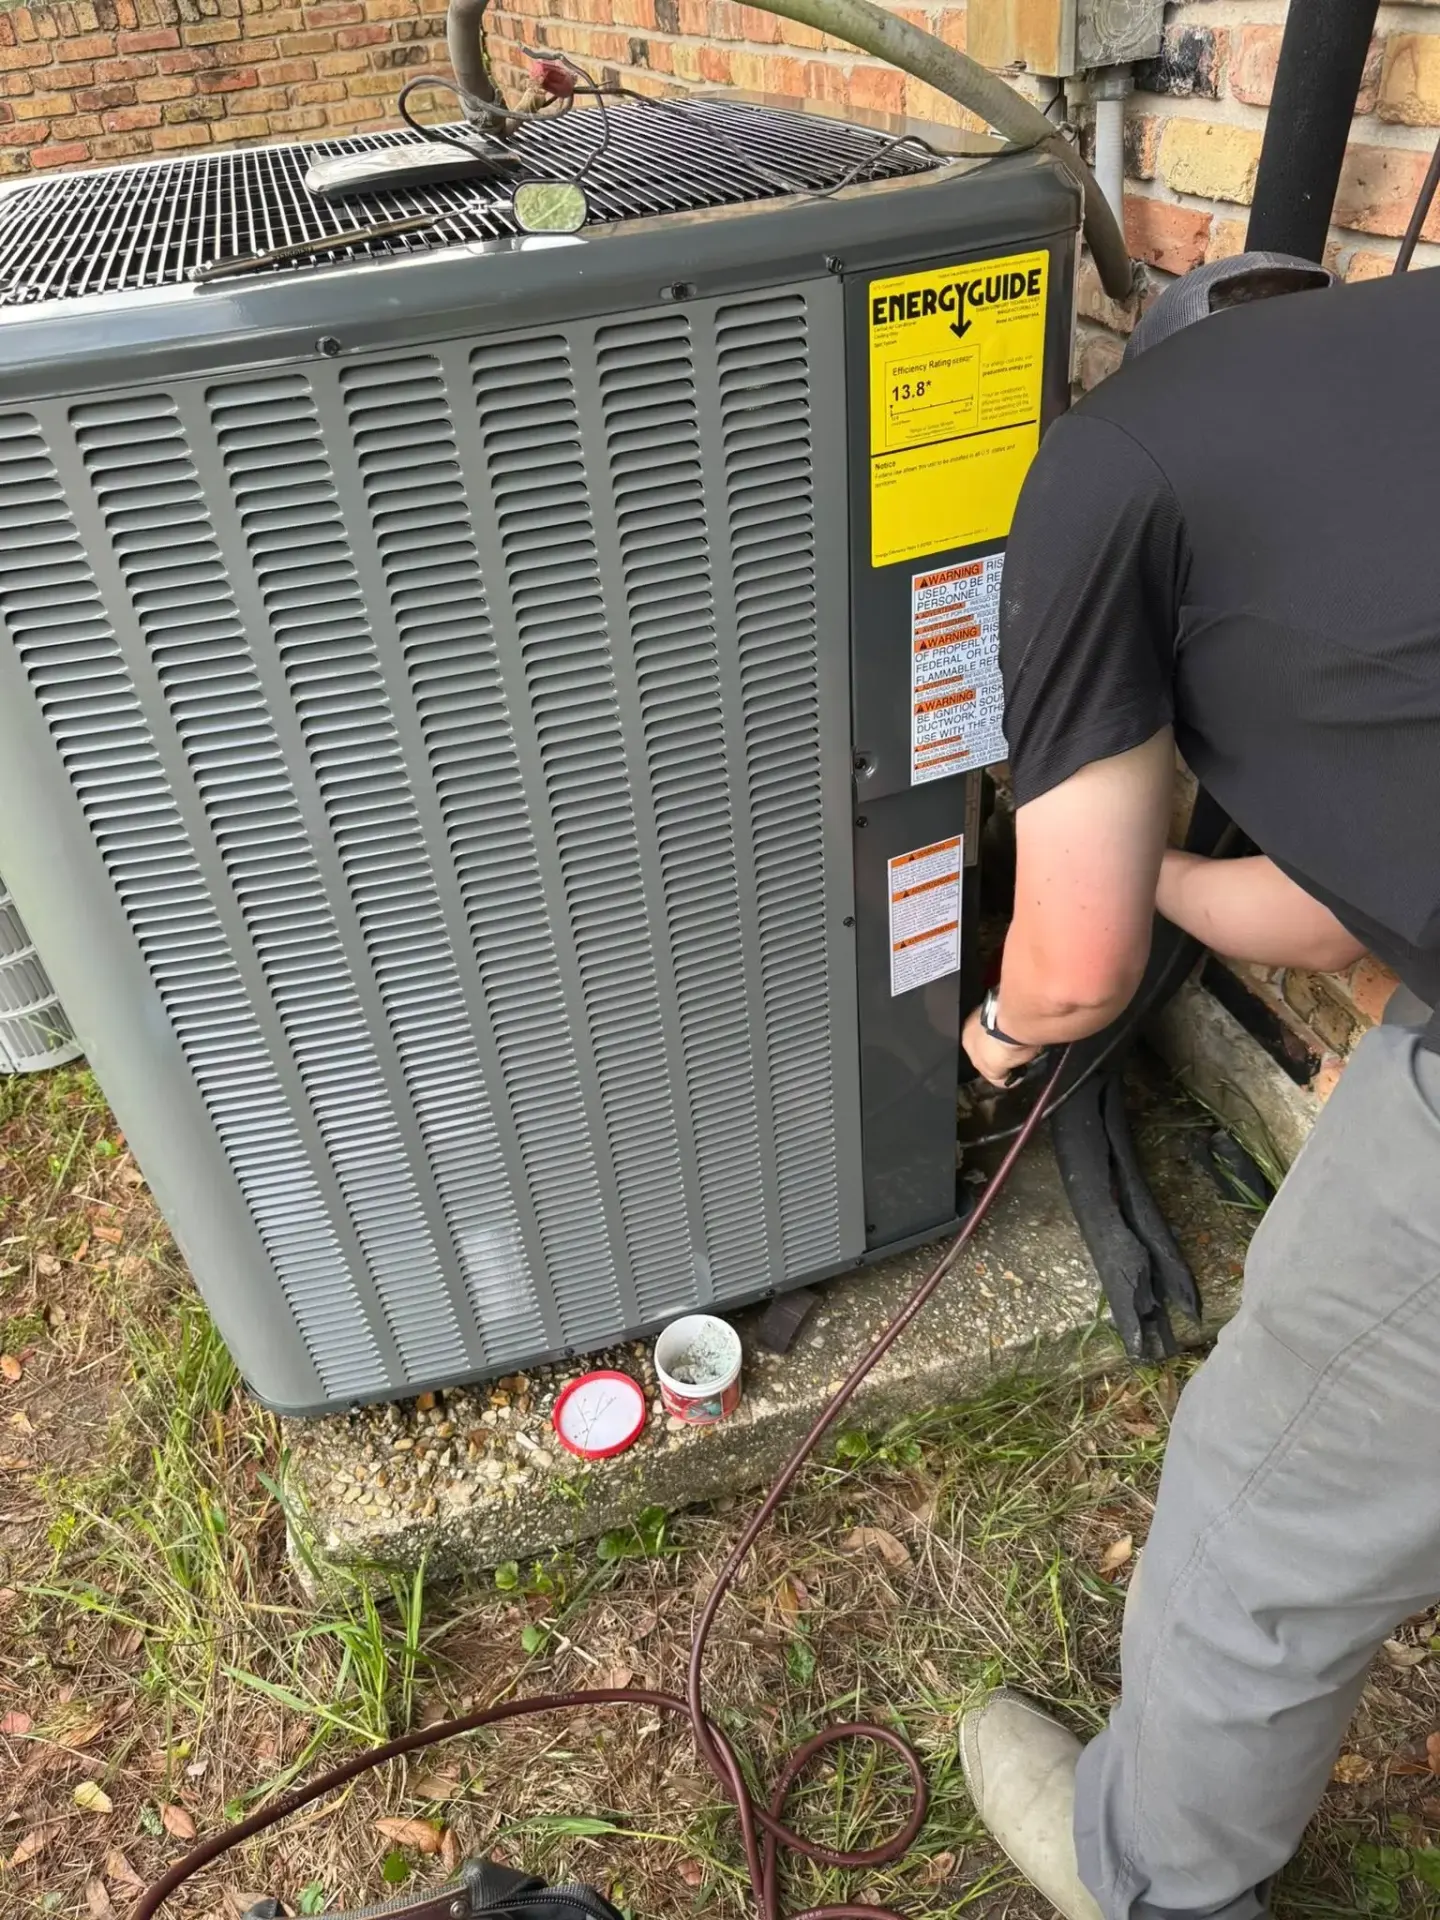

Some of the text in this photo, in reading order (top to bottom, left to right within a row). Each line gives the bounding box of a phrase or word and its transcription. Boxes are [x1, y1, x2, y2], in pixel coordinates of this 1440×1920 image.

[873, 268, 1042, 326] ENERGYGUIDE
[892, 364, 927, 376] Efficiency
[929, 359, 952, 368] Rating
[875, 461, 896, 470] Notice
[928, 558, 1004, 586] WARNING RIS
[953, 580, 967, 592] TO
[970, 575, 984, 588] BE
[986, 571, 1001, 582] RE
[915, 651, 929, 663] OF
[932, 635, 988, 659] PROPERLY
[927, 627, 978, 648] WARNING
[982, 622, 999, 633] RIS
[916, 643, 1000, 673] FEDERAL OR LO
[916, 655, 999, 684] FLAMMABLE REF
[917, 714, 930, 724] BE
[933, 701, 977, 719] IGNITION
[916, 732, 937, 745] USE
[939, 725, 965, 739] WITH
[968, 718, 986, 730] THE
[989, 714, 1002, 725] SP
